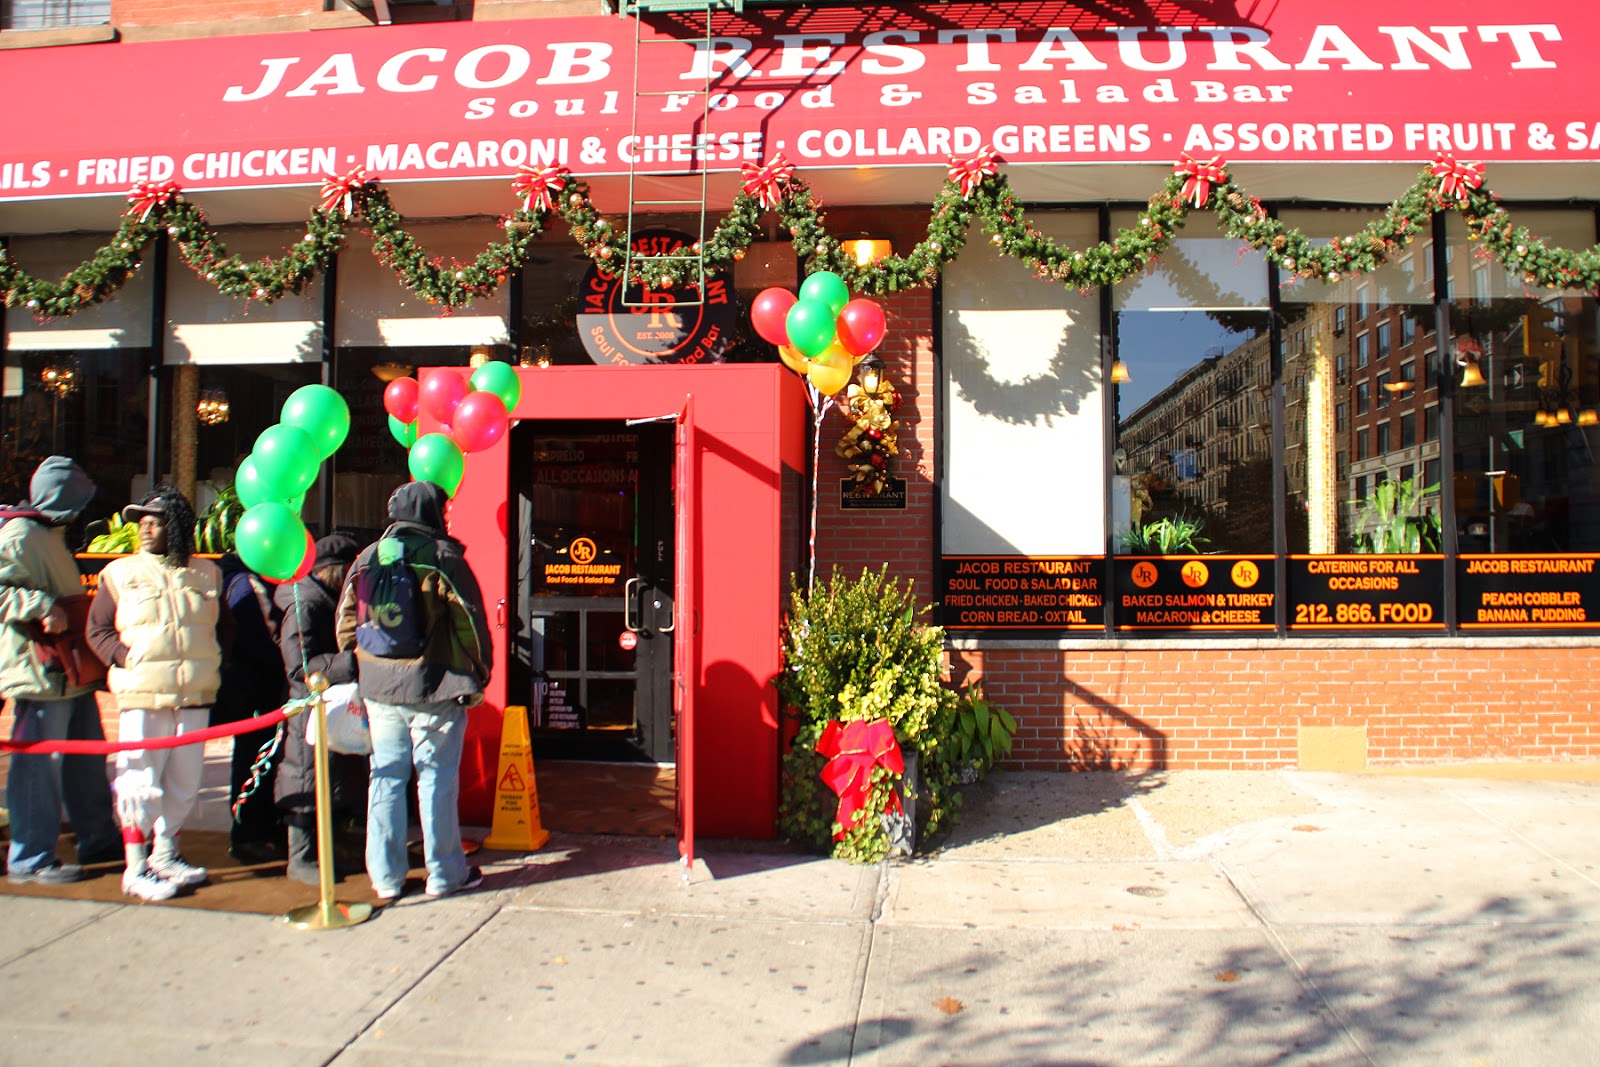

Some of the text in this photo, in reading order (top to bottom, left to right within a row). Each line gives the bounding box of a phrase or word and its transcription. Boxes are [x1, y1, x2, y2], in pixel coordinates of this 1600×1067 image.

[222, 24, 1562, 102] JACOB RESTAURANT
[464, 91, 618, 120] Soul
[661, 84, 834, 112] Food
[880, 84, 922, 107] &
[0, 161, 51, 190] ILS
[77, 155, 174, 186] FRIED
[183, 147, 337, 181] CHICKEN
[365, 138, 568, 178] MACARONI
[580, 136, 607, 164] &
[617, 132, 764, 163] CHEESE
[797, 127, 981, 159] COLLARD
[992, 124, 1151, 153] GREENS
[1184, 123, 1394, 152] ASSORTED
[1405, 123, 1516, 151] FRUIT
[1528, 122, 1556, 150] &
[591, 326, 615, 356] Soul
[701, 324, 721, 349] Bar
[655, 331, 675, 340] 2008
[575, 542, 591, 560] JR
[545, 564, 621, 575] JACOB RESTAURANT
[956, 562, 1091, 574] JACOB RESTAURANT
[1307, 561, 1420, 574] CATERING FOR ALL
[1466, 559, 1595, 574] JACOB RESTAURANT
[546, 576, 560, 584] Soul
[561, 576, 578, 584] Food
[1136, 566, 1153, 583] JR
[1186, 566, 1203, 582] JR
[1236, 566, 1253, 582] JR
[949, 578, 1097, 590] SOUL FOOD & SALAD BAR
[1328, 577, 1399, 590] OCCASIONS
[945, 594, 1102, 607] FRIED CHICKEN BAKED CHICKEN
[1122, 593, 1274, 607] BAKED SALMON & TURKEY
[1482, 592, 1580, 606] PEACH COBBLER
[960, 610, 1087, 623] CORN BREAD OXTAIL
[1136, 610, 1261, 623] MACARONI & CHEESE
[1295, 603, 1433, 623] 212. 866. FOOD
[1477, 608, 1587, 622] BANANA PUDDING
